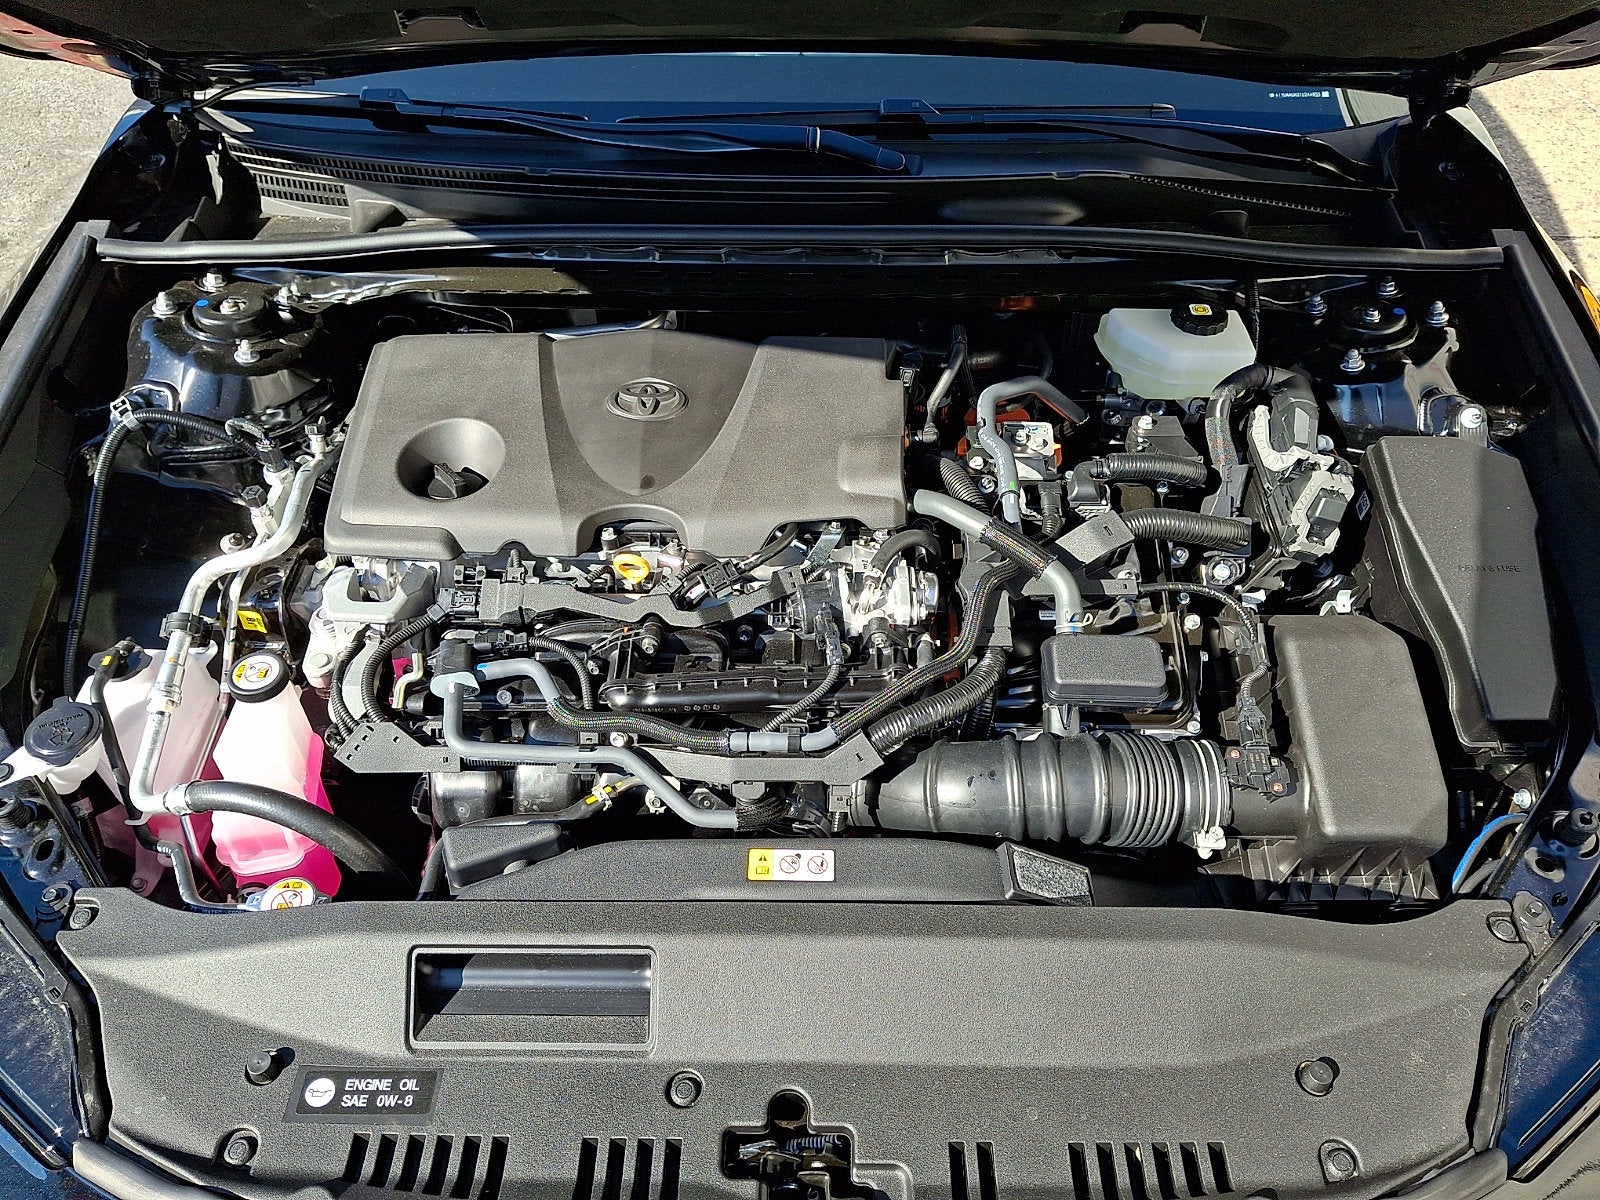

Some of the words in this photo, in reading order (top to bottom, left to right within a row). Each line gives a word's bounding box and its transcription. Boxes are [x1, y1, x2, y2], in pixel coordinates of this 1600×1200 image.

[344, 1079, 392, 1091] ENGINE
[399, 1079, 420, 1091] OIL
[341, 1095, 368, 1107] SAE
[376, 1095, 414, 1107] 0W-8
